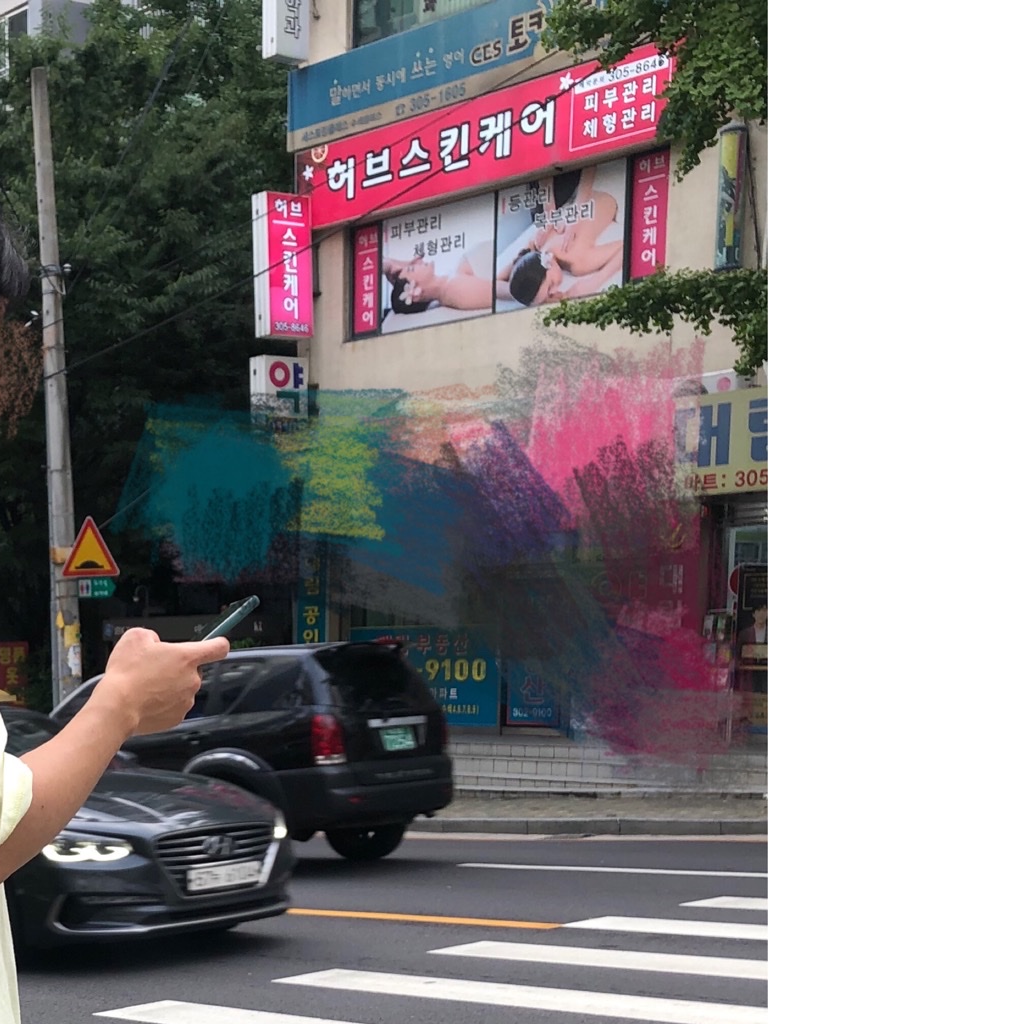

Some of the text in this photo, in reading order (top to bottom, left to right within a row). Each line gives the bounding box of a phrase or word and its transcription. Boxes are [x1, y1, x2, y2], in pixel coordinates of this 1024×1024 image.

[376, 67, 406, 91] 동시에
[470, 40, 502, 65] CES
[584, 74, 657, 113] 피부관리
[583, 101, 656, 138] 체형관리
[326, 96, 557, 201] 허브스킨케어
[639, 155, 666, 174] 허브
[274, 199, 303, 218] 허브
[390, 214, 442, 240] 피부관리
[641, 185, 659, 267] 스킨케어
[413, 232, 466, 258] 체형관리
[281, 228, 299, 320] 스킨케어
[362, 257, 375, 326] 스킨케어
